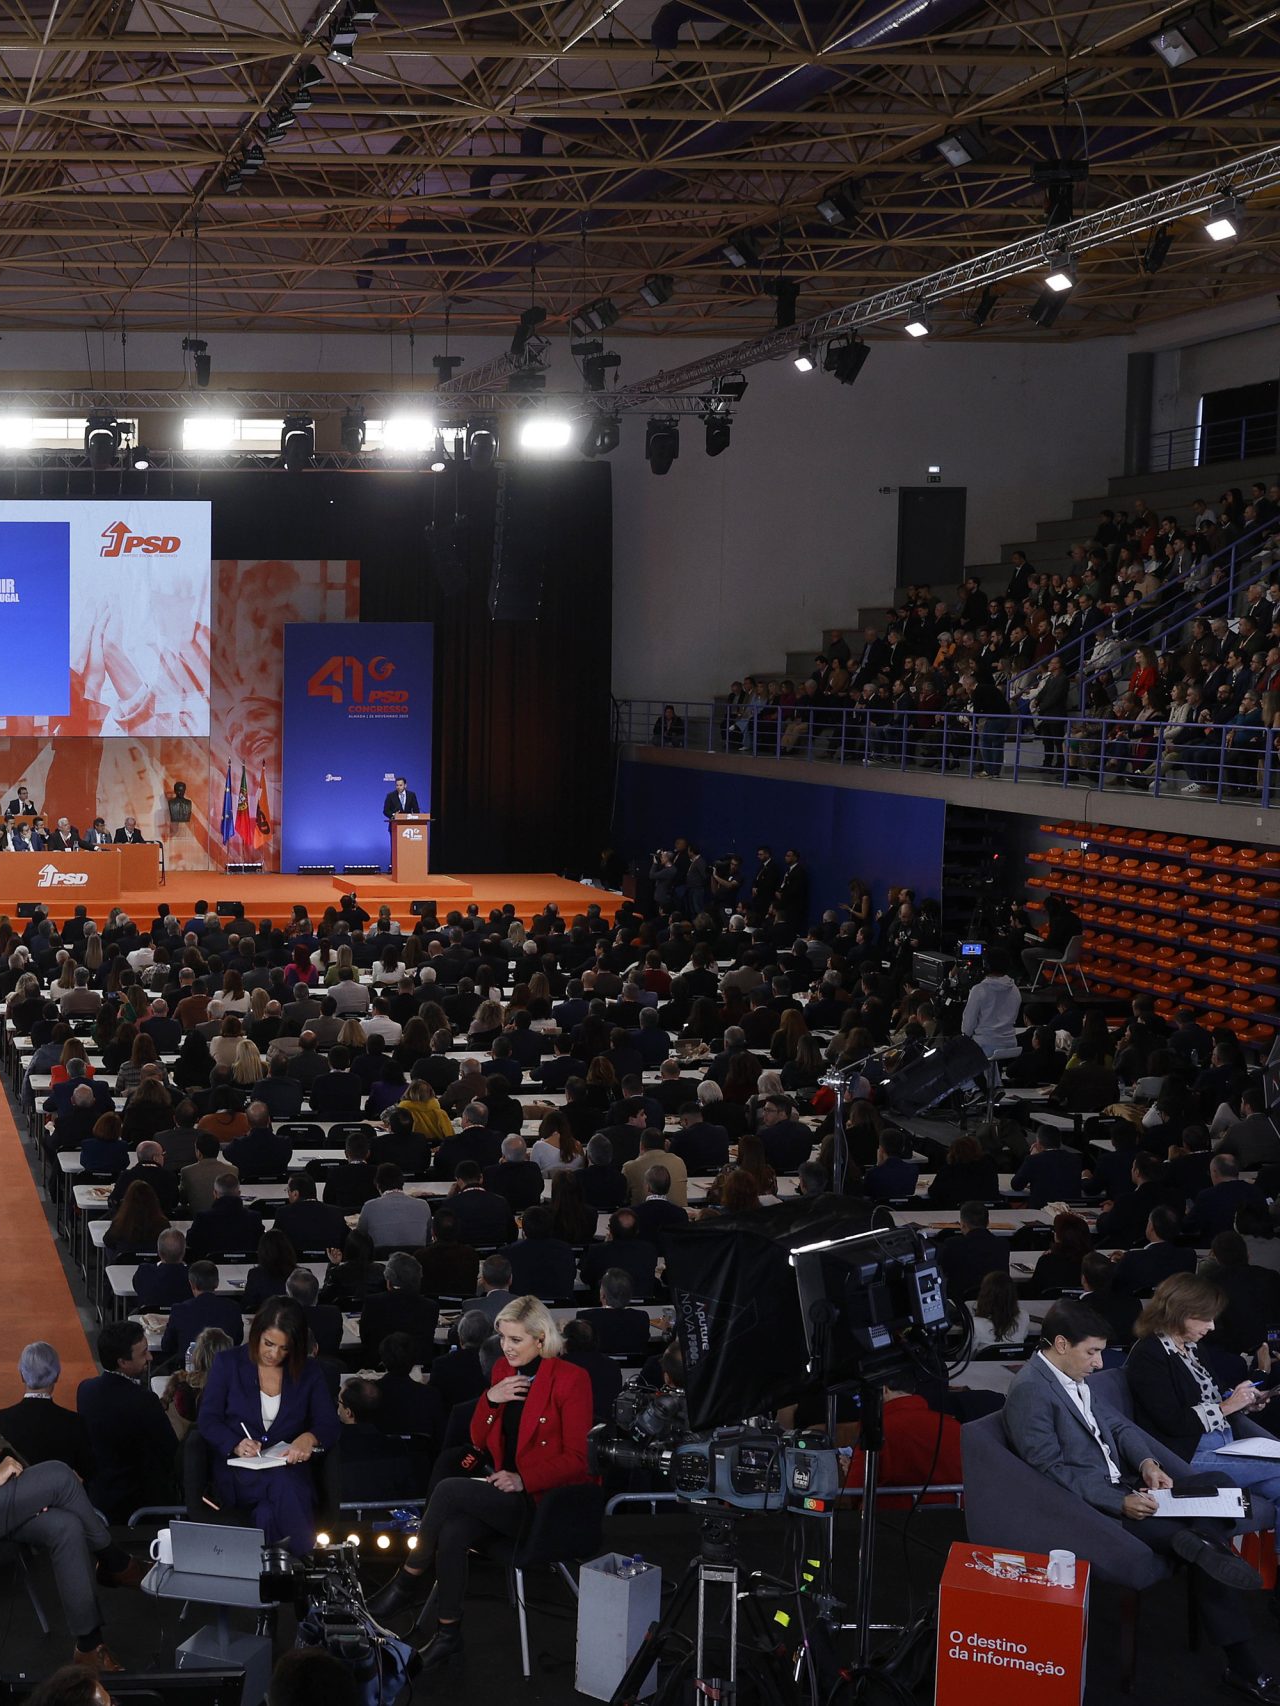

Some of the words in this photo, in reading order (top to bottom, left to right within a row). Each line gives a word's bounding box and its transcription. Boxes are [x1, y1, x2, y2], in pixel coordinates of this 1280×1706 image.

[124, 536, 181, 553] PSD
[368, 690, 409, 704] PSD
[348, 705, 409, 713] CONGRESSO
[51, 873, 89, 885] PSD
[680, 1293, 695, 1334] NOVA
[695, 1301, 710, 1351] Aputure
[461, 1453, 477, 1469] CNN
[949, 1630, 963, 1643] O
[967, 1633, 1028, 1655] destino
[949, 1647, 969, 1661] da
[973, 1649, 1066, 1677] informação
